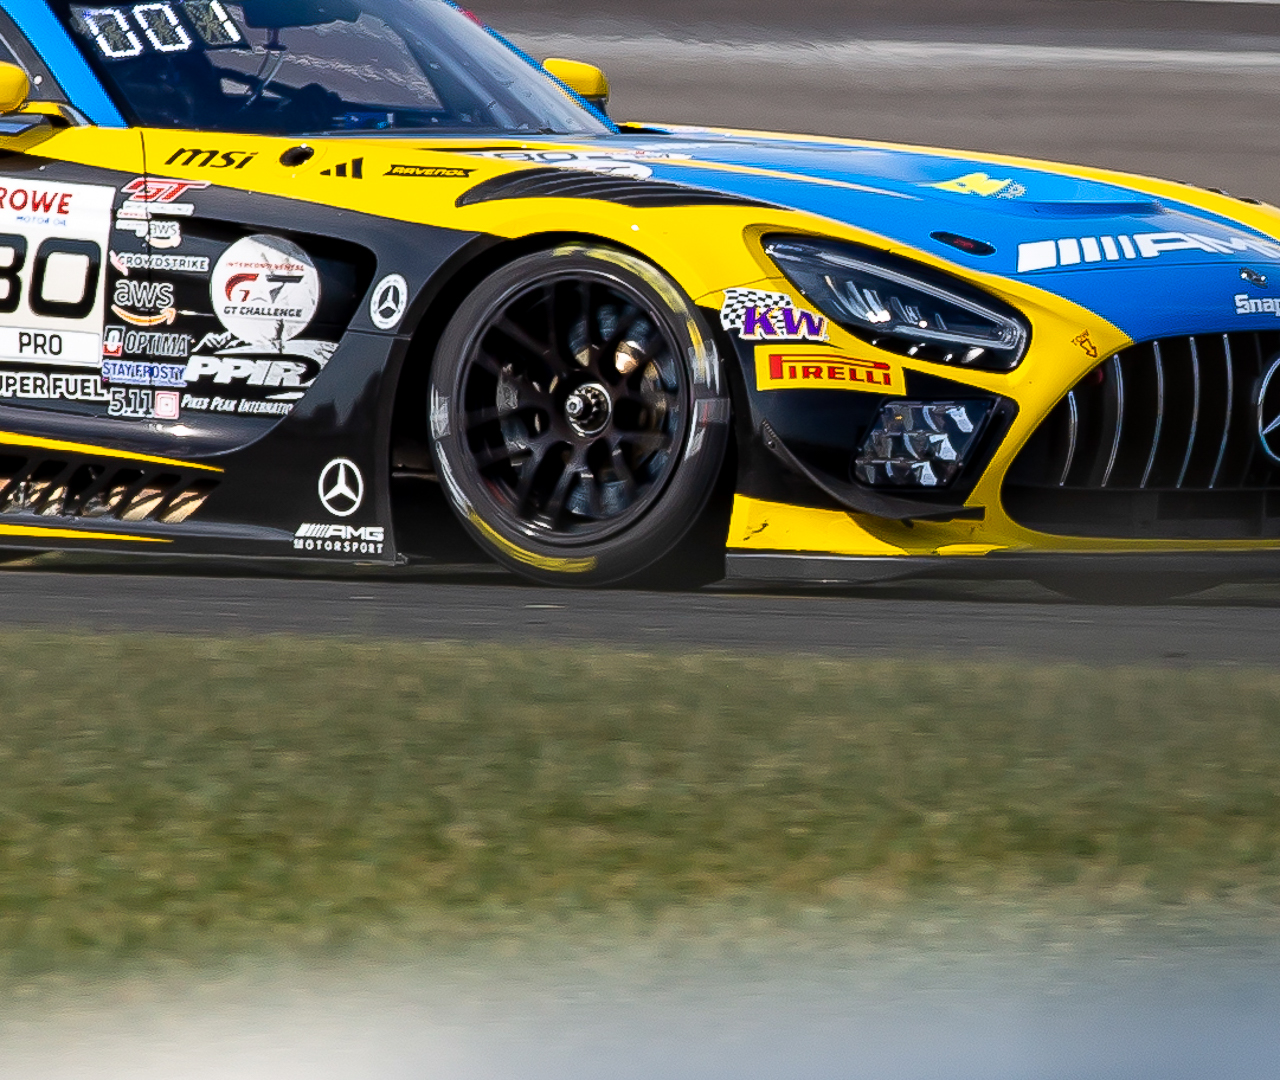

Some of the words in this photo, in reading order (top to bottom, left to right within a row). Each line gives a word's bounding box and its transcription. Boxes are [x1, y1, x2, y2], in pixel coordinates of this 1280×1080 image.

[165, 146, 259, 170] msi
[118, 254, 208, 271] CROWDSTRIKE
[114, 279, 174, 309] aws
[223, 305, 239, 316] GT
[239, 306, 303, 318] CHALLENGE
[742, 304, 826, 339] KW
[18, 331, 63, 356] PRO
[124, 331, 188, 357] OPTIMA
[102, 361, 131, 377] STAY
[133, 363, 187, 381] FROSTY
[184, 355, 306, 386] PPIR
[769, 353, 892, 386] PIRELLI
[51, 376, 106, 400] FUEL
[108, 388, 154, 417] 5.11
[293, 537, 384, 554] MOTORSPORT
